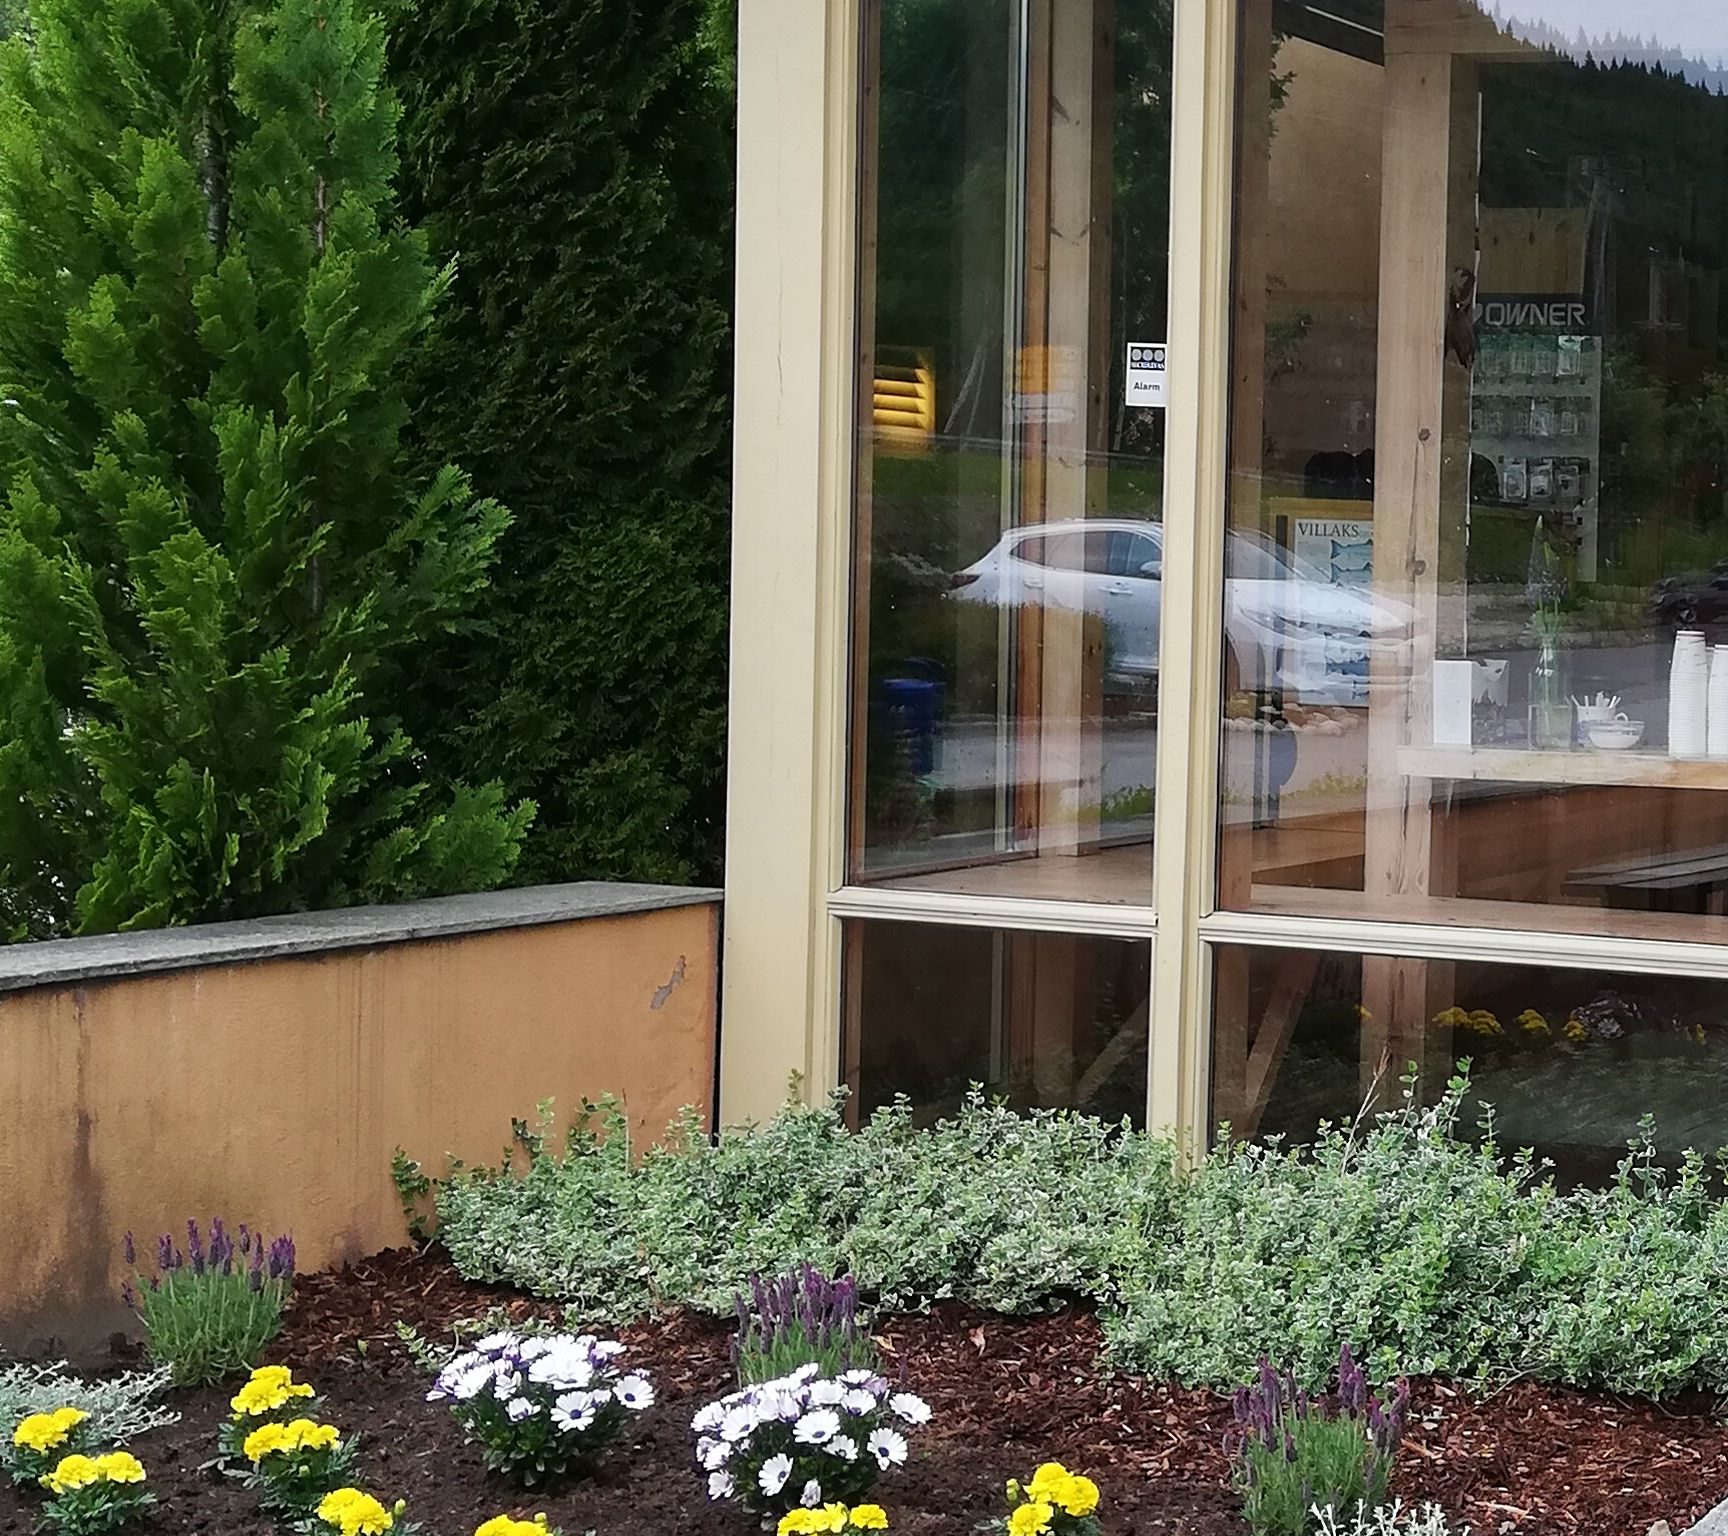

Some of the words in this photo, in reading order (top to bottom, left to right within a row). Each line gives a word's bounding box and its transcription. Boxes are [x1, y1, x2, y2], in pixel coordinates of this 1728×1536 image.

[1485, 302, 1586, 326] OWNER
[1133, 382, 1160, 391] Alarm
[1298, 523, 1359, 537] VILLAKS
